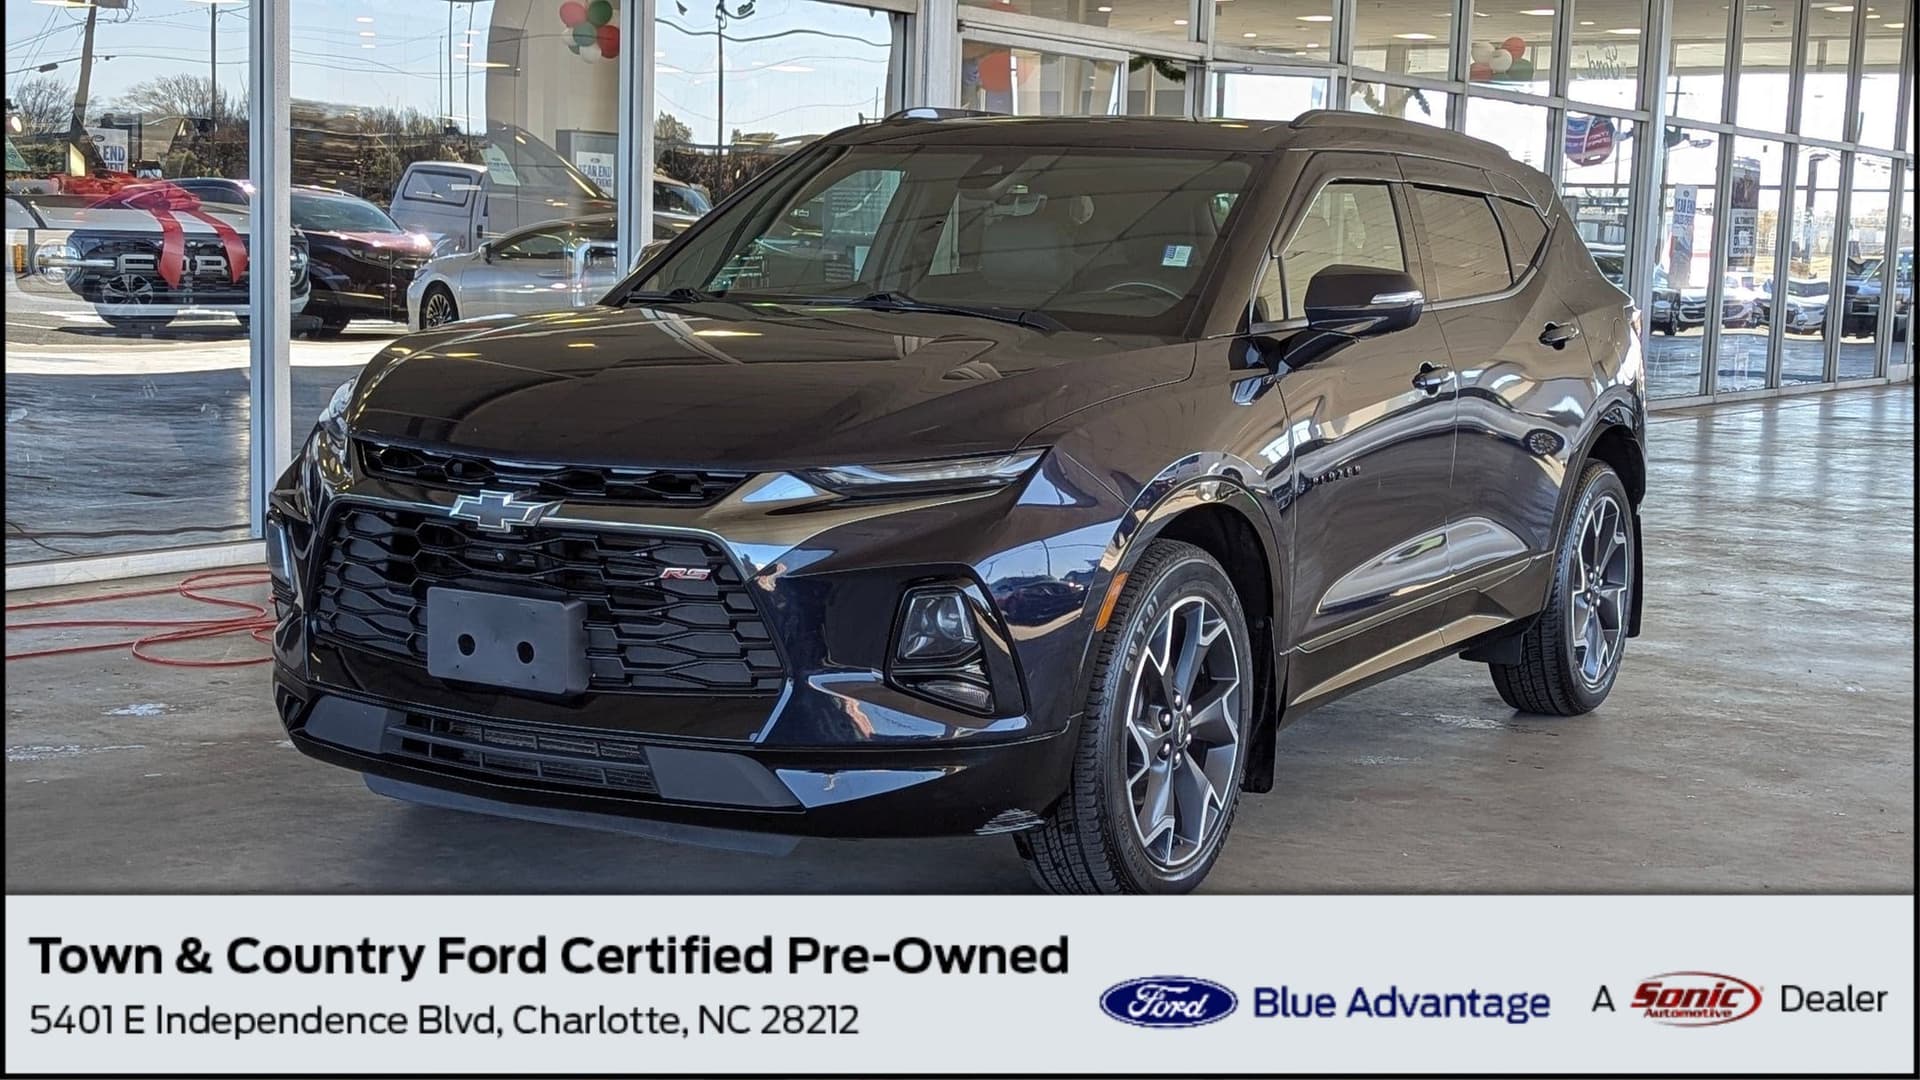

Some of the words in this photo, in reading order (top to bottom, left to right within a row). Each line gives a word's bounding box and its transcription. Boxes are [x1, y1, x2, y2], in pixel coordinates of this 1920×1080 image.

[103, 145, 125, 162] END
[600, 165, 613, 178] END
[660, 567, 711, 580] RS
